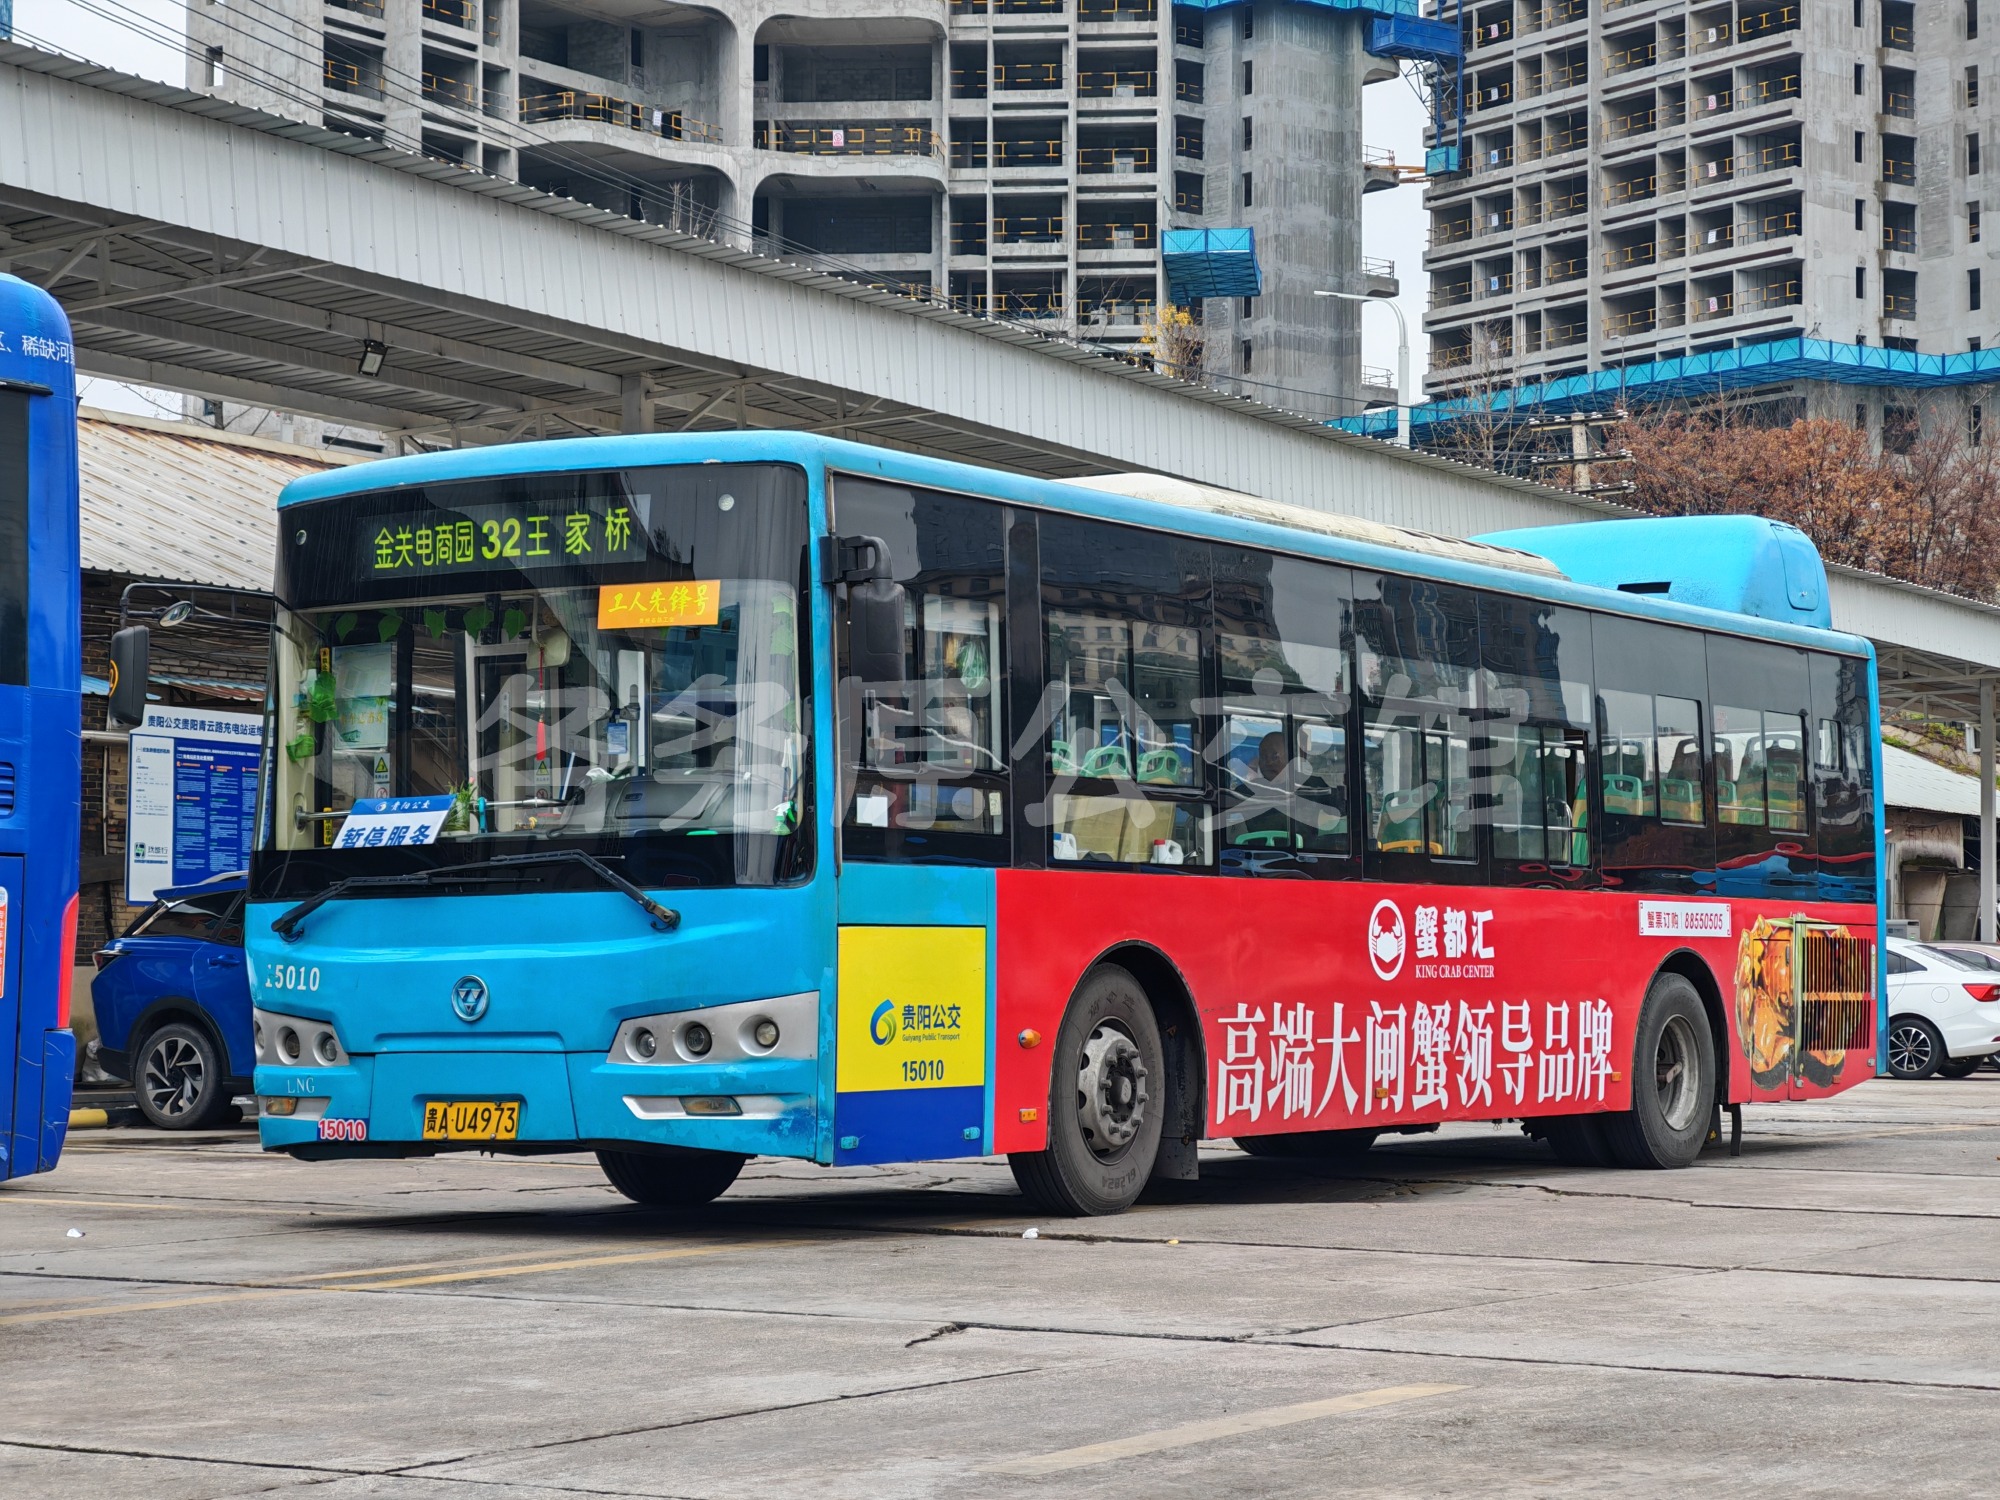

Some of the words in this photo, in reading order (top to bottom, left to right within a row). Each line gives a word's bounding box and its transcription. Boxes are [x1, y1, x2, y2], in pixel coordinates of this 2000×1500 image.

[374, 520, 474, 570] 金关电商园
[481, 517, 521, 560] 32
[526, 507, 631, 557] 王家桥
[607, 584, 710, 617] 工人先锋号
[390, 800, 431, 811] 贵阳公交
[341, 823, 431, 849] 暂停服务
[1414, 905, 1495, 959] 蟹都汇
[1647, 911, 1679, 929] 蟹票订购
[1684, 912, 1723, 930] 88550505
[1415, 964, 1438, 979] KING
[1439, 964, 1462, 979] CRAB
[1462, 964, 1495, 979] CENTER
[902, 1003, 961, 1031] 贵阳公交
[902, 1034, 922, 1043] Guiyang
[922, 1033, 937, 1041] Public
[938, 1033, 960, 1041] Transport
[902, 1059, 945, 1082] 15010
[1216, 998, 1614, 1125] 高端大闸蟹领导品牌
[287, 1077, 315, 1094] LNG
[318, 1118, 367, 1141] 15010
[426, 1107, 516, 1133] 贵A·U4973
